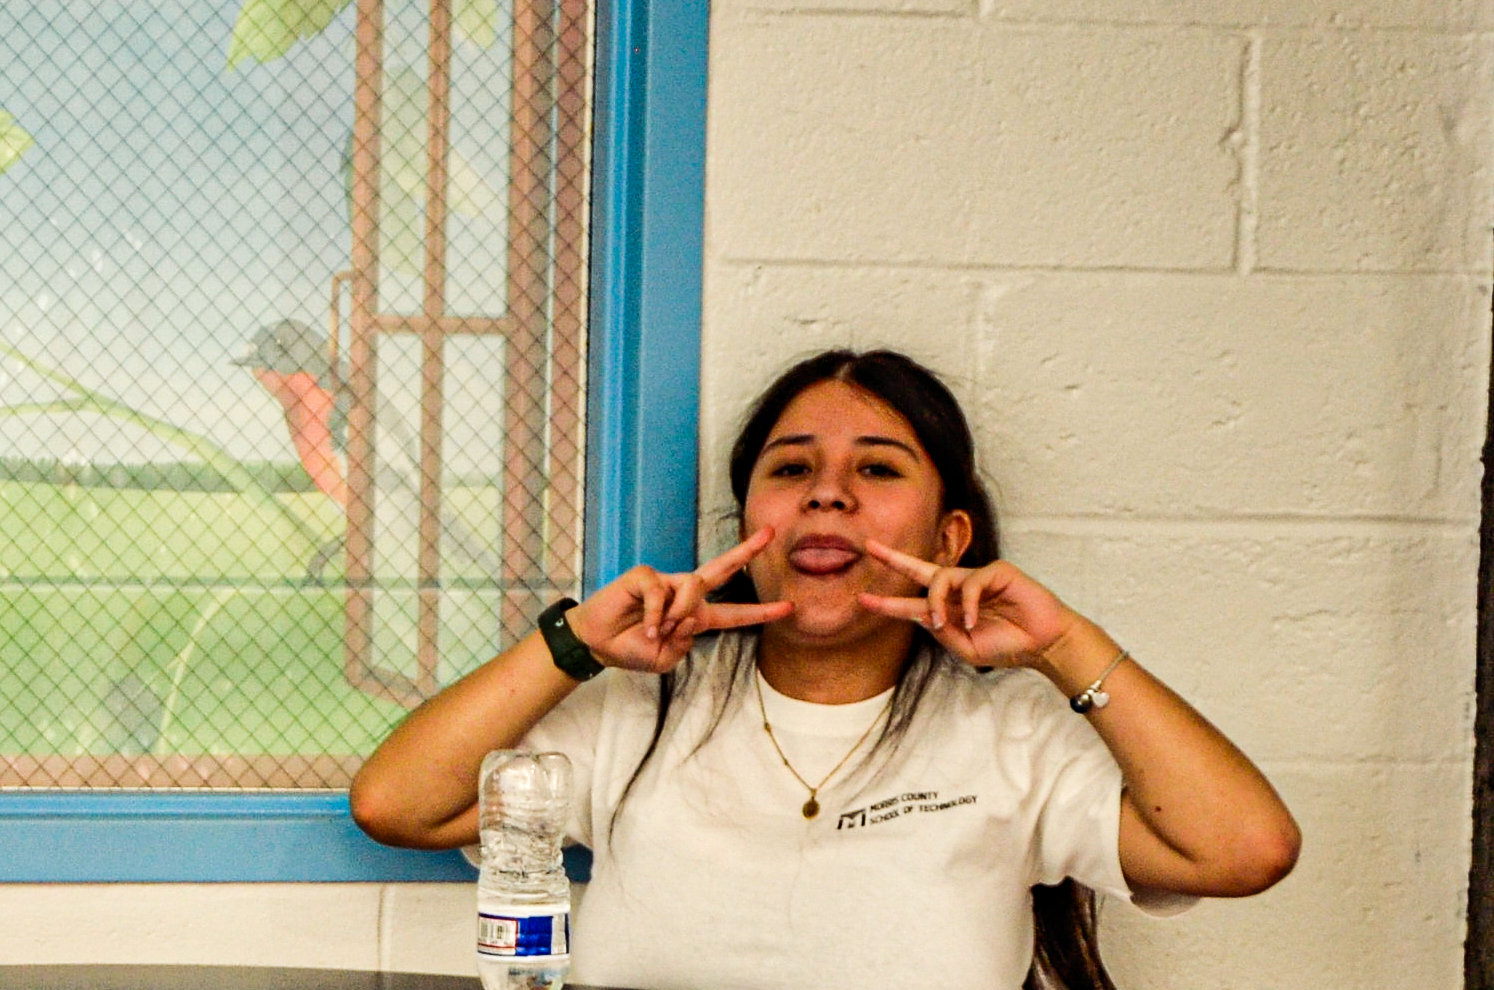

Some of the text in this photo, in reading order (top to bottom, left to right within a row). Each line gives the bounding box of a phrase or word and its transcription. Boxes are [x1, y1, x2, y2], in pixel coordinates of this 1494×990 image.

[870, 791, 938, 812] MORRIS COUNTY
[870, 795, 978, 824] SCHOOL OF TECHNOLOGY
